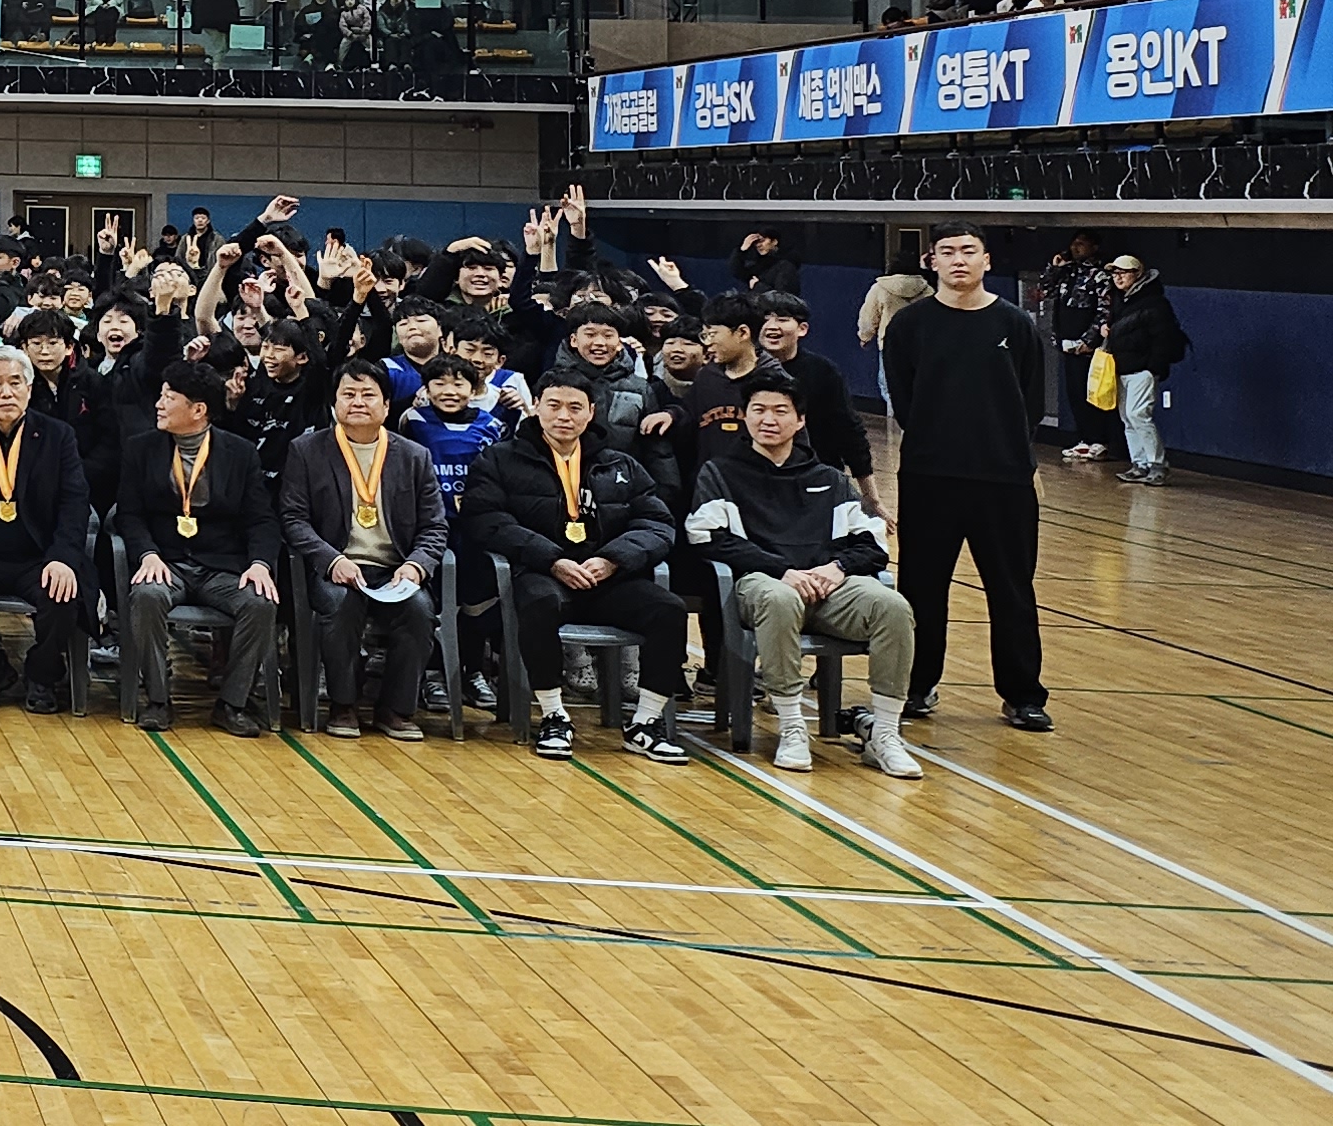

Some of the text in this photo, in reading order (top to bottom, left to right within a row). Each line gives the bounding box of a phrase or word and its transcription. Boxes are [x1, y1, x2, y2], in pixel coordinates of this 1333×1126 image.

[935, 47, 1031, 112] 영통KT
[1105, 25, 1228, 100] 용인KT
[694, 79, 757, 129] 강남SK
[797, 70, 824, 122] 세종
